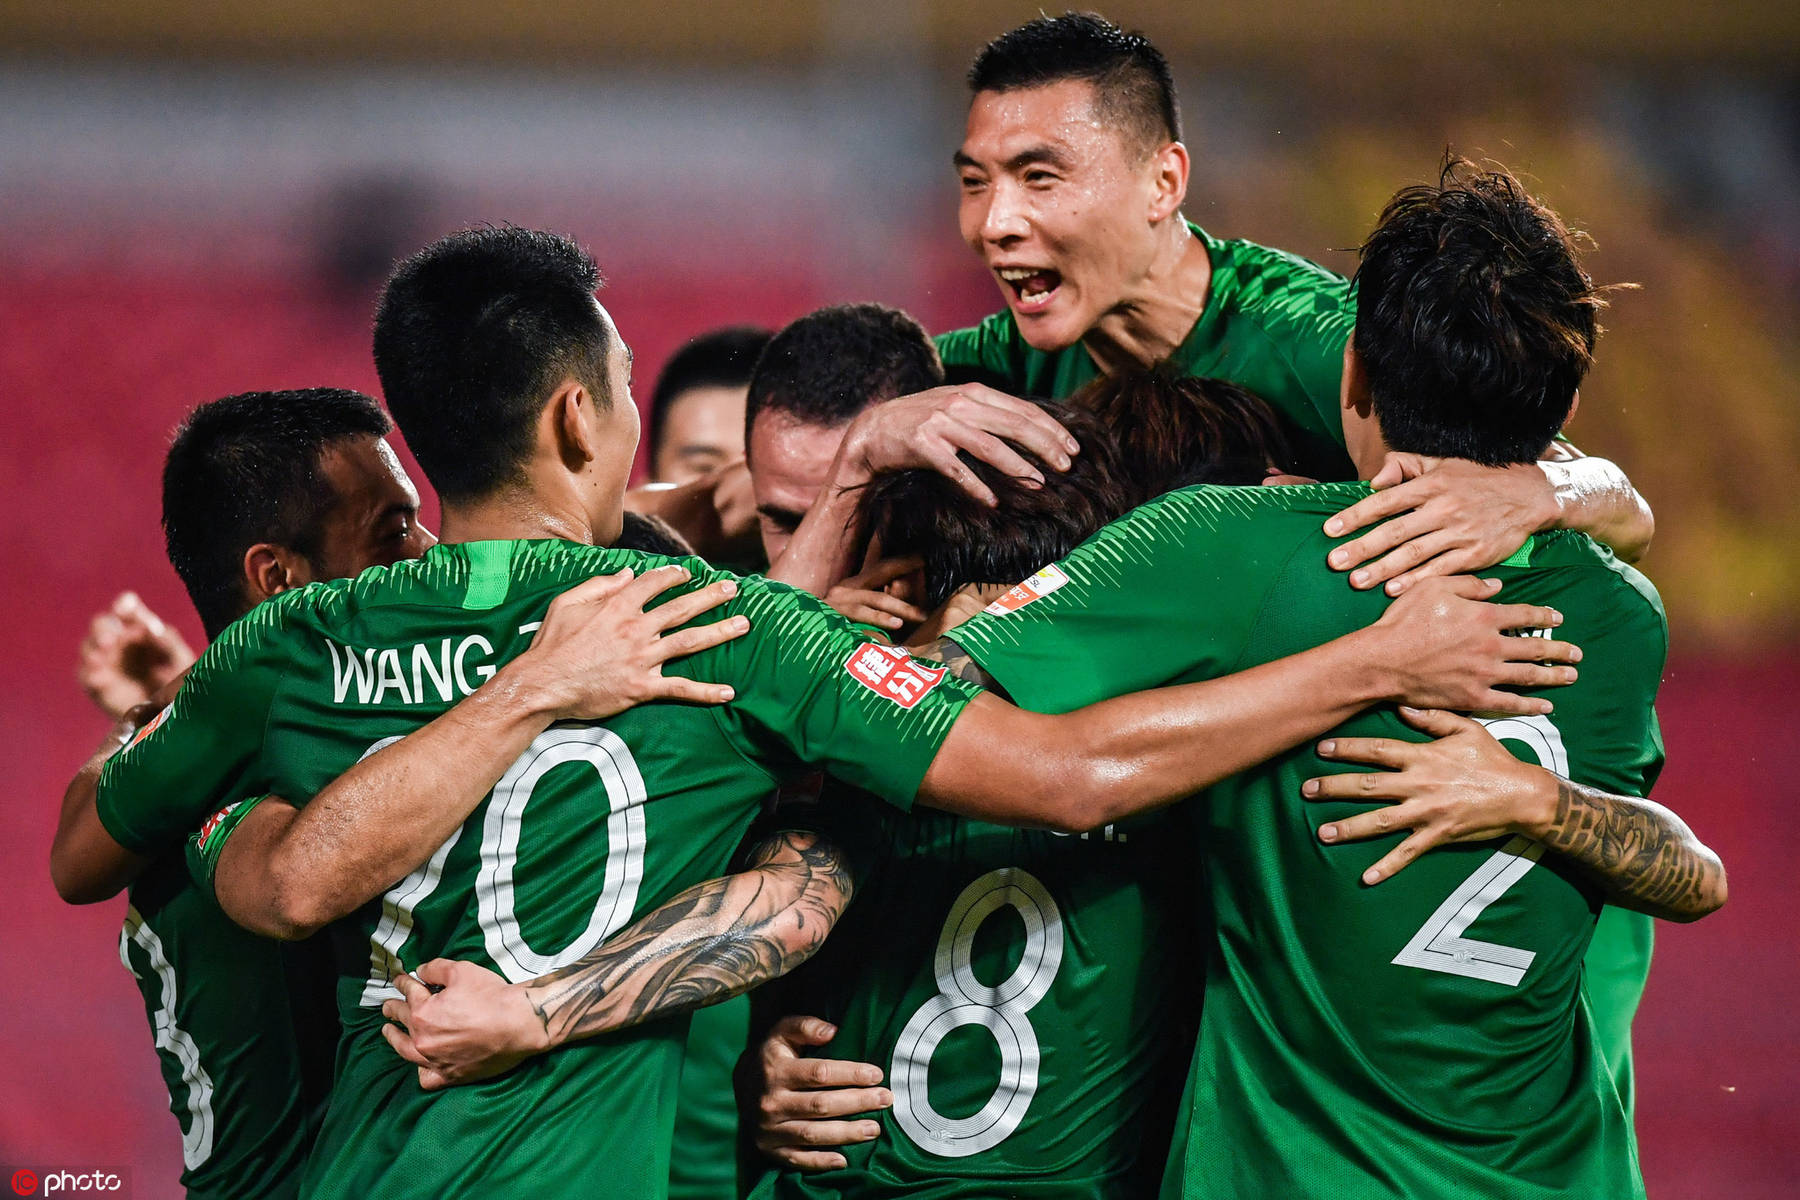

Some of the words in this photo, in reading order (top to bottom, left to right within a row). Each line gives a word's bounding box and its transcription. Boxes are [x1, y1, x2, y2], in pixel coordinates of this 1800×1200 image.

[325, 634, 497, 704] WANG
[1391, 710, 1569, 986] 2
[890, 867, 1064, 1158] 8
